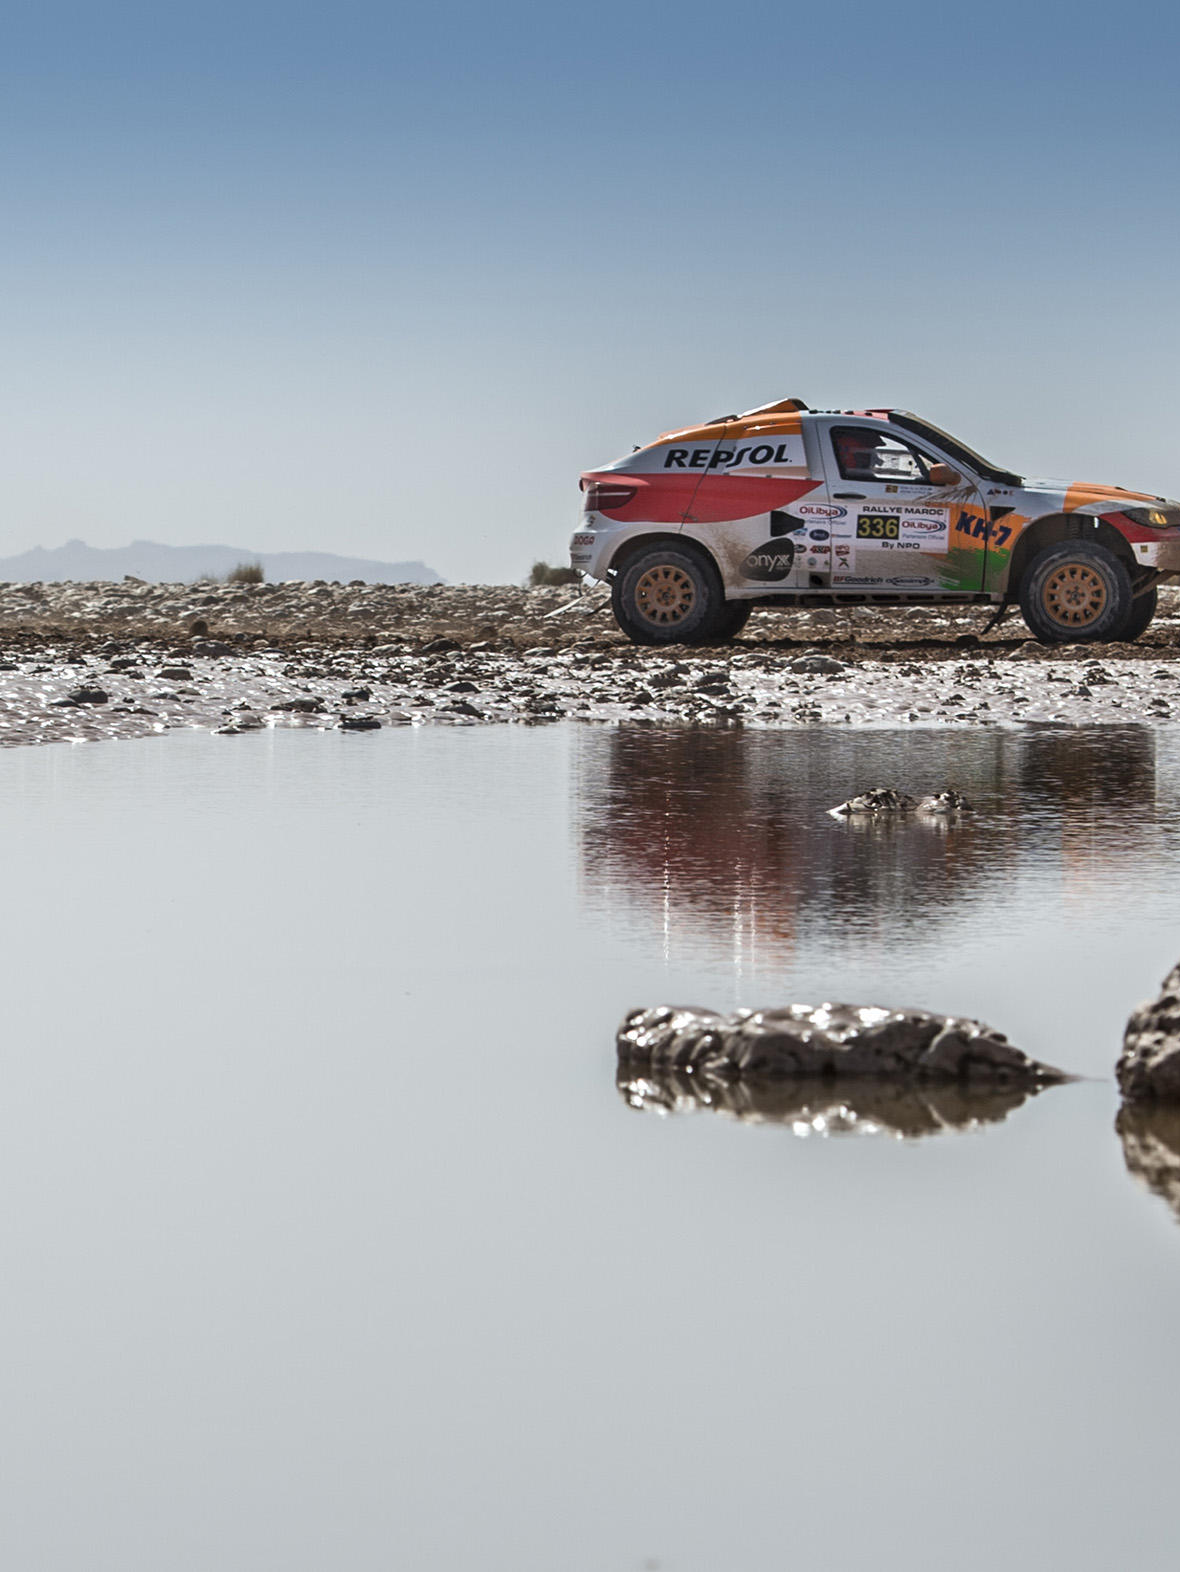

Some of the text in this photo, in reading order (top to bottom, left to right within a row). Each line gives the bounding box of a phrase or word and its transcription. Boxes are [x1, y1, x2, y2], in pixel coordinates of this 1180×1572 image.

[663, 444, 789, 469] REPSOL
[799, 506, 839, 516] OiLibya
[862, 506, 945, 516] RALLYE MAROC
[858, 518, 898, 538] 336
[901, 521, 939, 531] OiLibya
[955, 510, 1012, 546] KH-7
[881, 541, 921, 550] By NPO
[833, 575, 883, 584] BFGoodrich
